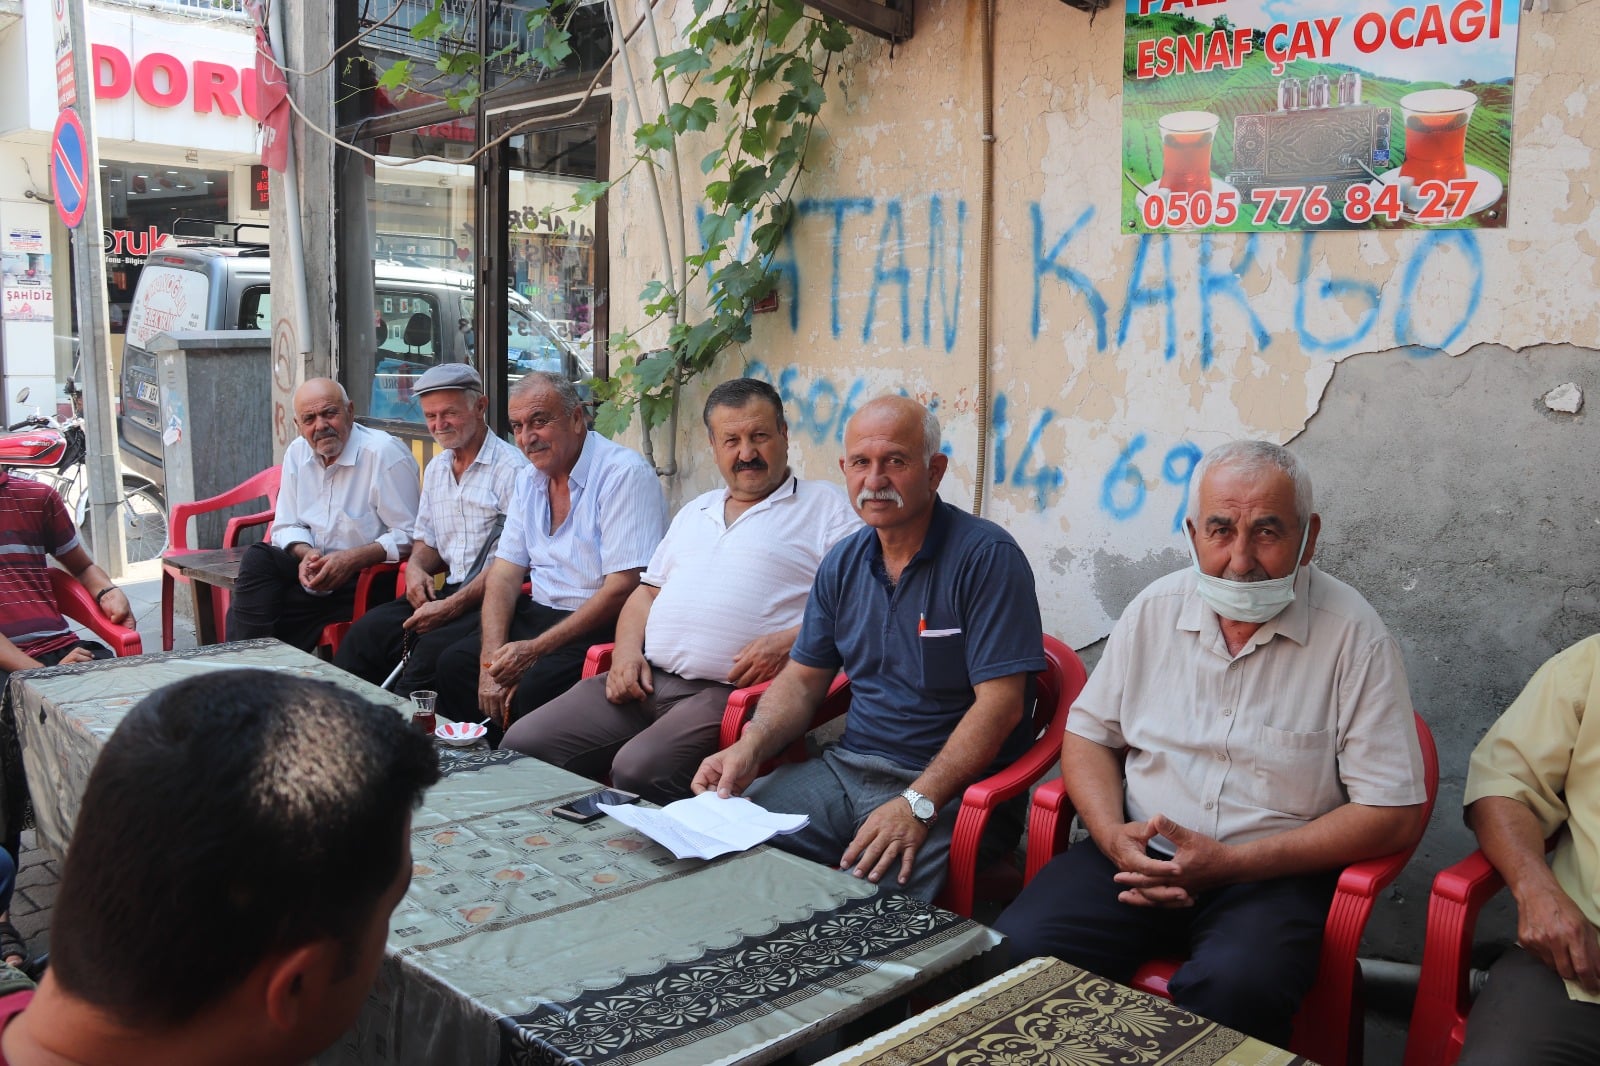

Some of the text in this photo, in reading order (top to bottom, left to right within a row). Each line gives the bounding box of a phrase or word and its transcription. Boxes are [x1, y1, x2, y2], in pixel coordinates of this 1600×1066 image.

[1137, 28, 1252, 78] ESNAF
[1265, 17, 1342, 75] ÇAY
[1142, 179, 1480, 228] 0505 776 84 27
[7, 289, 52, 302] ŞAHİDİZ
[1029, 200, 1484, 372] KARGO
